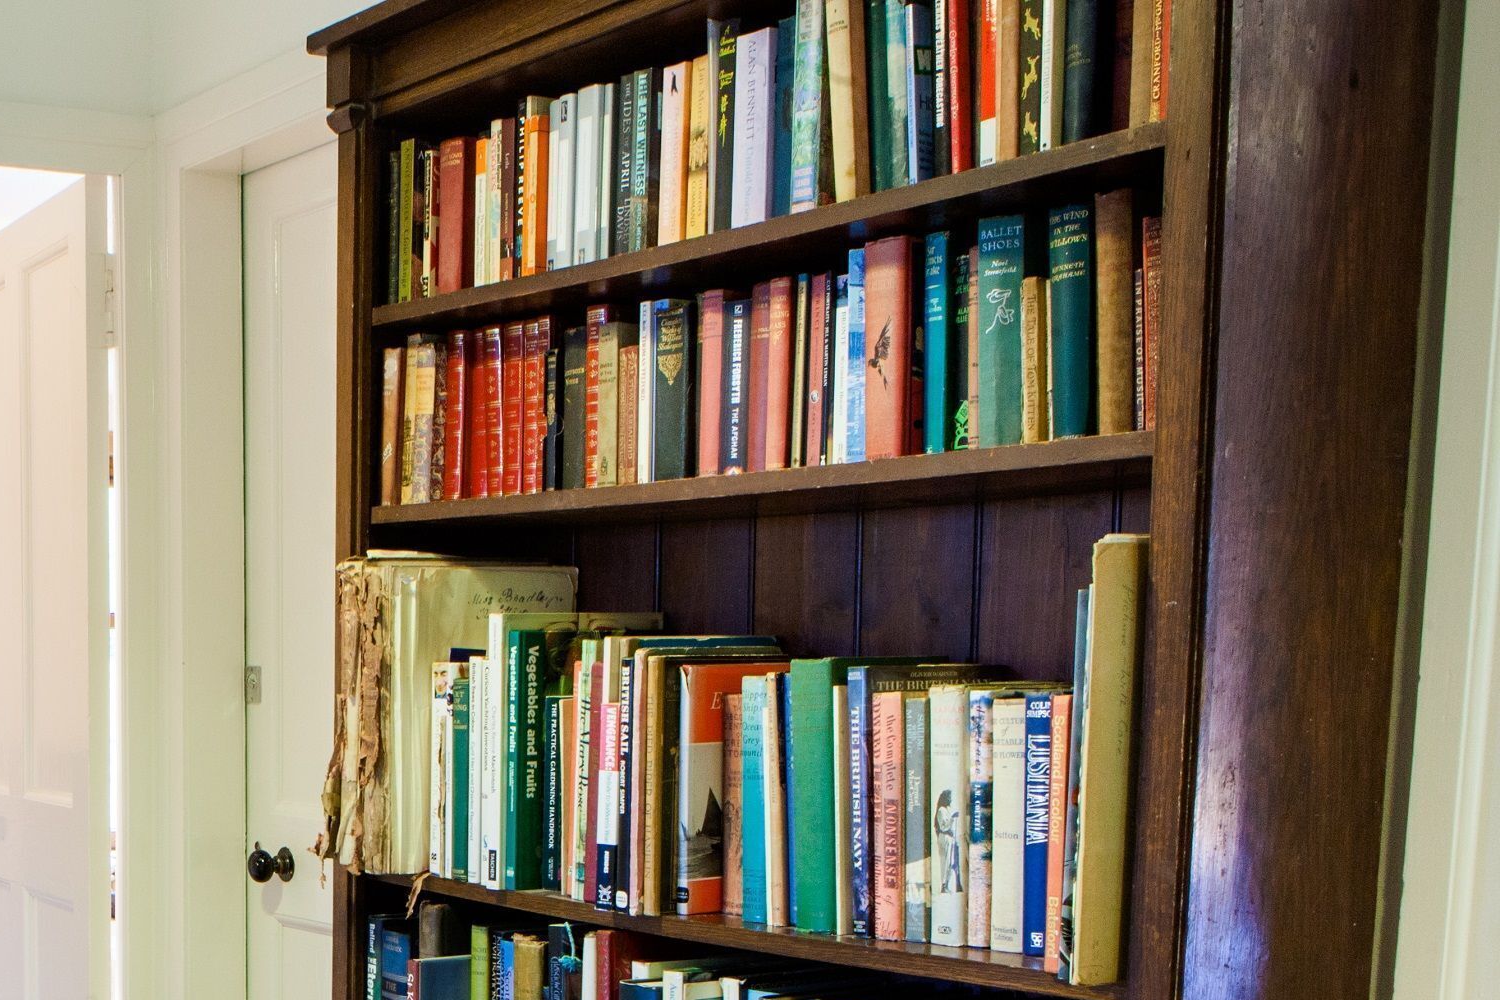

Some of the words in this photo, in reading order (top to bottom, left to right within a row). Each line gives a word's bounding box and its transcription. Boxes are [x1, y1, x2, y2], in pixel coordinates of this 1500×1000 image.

[746, 40, 757, 75] ALAN
[637, 75, 649, 98] THE
[935, 72, 944, 128] FORECASTING
[622, 101, 633, 134] IDES
[636, 103, 648, 135] LAST
[745, 79, 756, 142] BENNETT
[518, 117, 526, 172] PHILIP
[620, 150, 632, 193] APRIL
[635, 140, 647, 197] WITNESS
[517, 175, 525, 228] REEVE
[1062, 209, 1089, 222] WIND
[616, 206, 625, 241] DAVIS
[622, 198, 632, 245] LINDSEY
[980, 225, 1023, 240] BALLET
[1053, 225, 1063, 236] IN
[1063, 223, 1082, 232] THE
[982, 240, 1020, 253] SHOES
[1026, 296, 1037, 314] THE
[1135, 282, 1143, 296] IN
[1026, 319, 1036, 345] TALE
[1135, 299, 1143, 344] PRAISE
[732, 318, 744, 362] FREDERICK
[1026, 347, 1036, 363] OF
[1135, 347, 1143, 362] OF
[730, 362, 743, 405] FORSYTH
[1026, 366, 1036, 388] TOM
[731, 408, 740, 420] THE
[1025, 391, 1036, 431] KITTEN
[730, 426, 740, 460] AFGHAN
[483, 666, 491, 697] Curious
[509, 645, 517, 701] Vegetables
[525, 645, 539, 725] Vegetables
[876, 680, 904, 691] THE
[550, 703, 558, 718] THE
[620, 666, 630, 723] BRITISH
[509, 703, 517, 723] and
[850, 706, 861, 745] THE
[886, 714, 896, 733] the
[509, 725, 517, 753] Fruits
[526, 728, 538, 756] and
[549, 718, 557, 760] PRACTICAL
[577, 731, 591, 770] Mary
[604, 707, 617, 771] VENGEANCE:
[619, 725, 629, 756] SAIL
[1052, 714, 1065, 781] Scotland
[525, 761, 538, 799] Fruits
[883, 734, 896, 792] Complete
[548, 760, 557, 806] GARDENING
[576, 774, 589, 809] Rose
[850, 748, 862, 823] BRITISH
[1025, 733, 1051, 846] LUSITANIA
[1052, 783, 1063, 796] in
[547, 806, 556, 849] HANDBOOK
[994, 830, 1020, 841] Sutton
[1051, 797, 1063, 844] colour
[852, 826, 863, 872] NAVY
[884, 803, 899, 884] NONSENSE
[368, 923, 376, 955] Ballard
[1047, 895, 1060, 958] Batsford
[385, 981, 397, 992] THE
[406, 973, 415, 988] St
